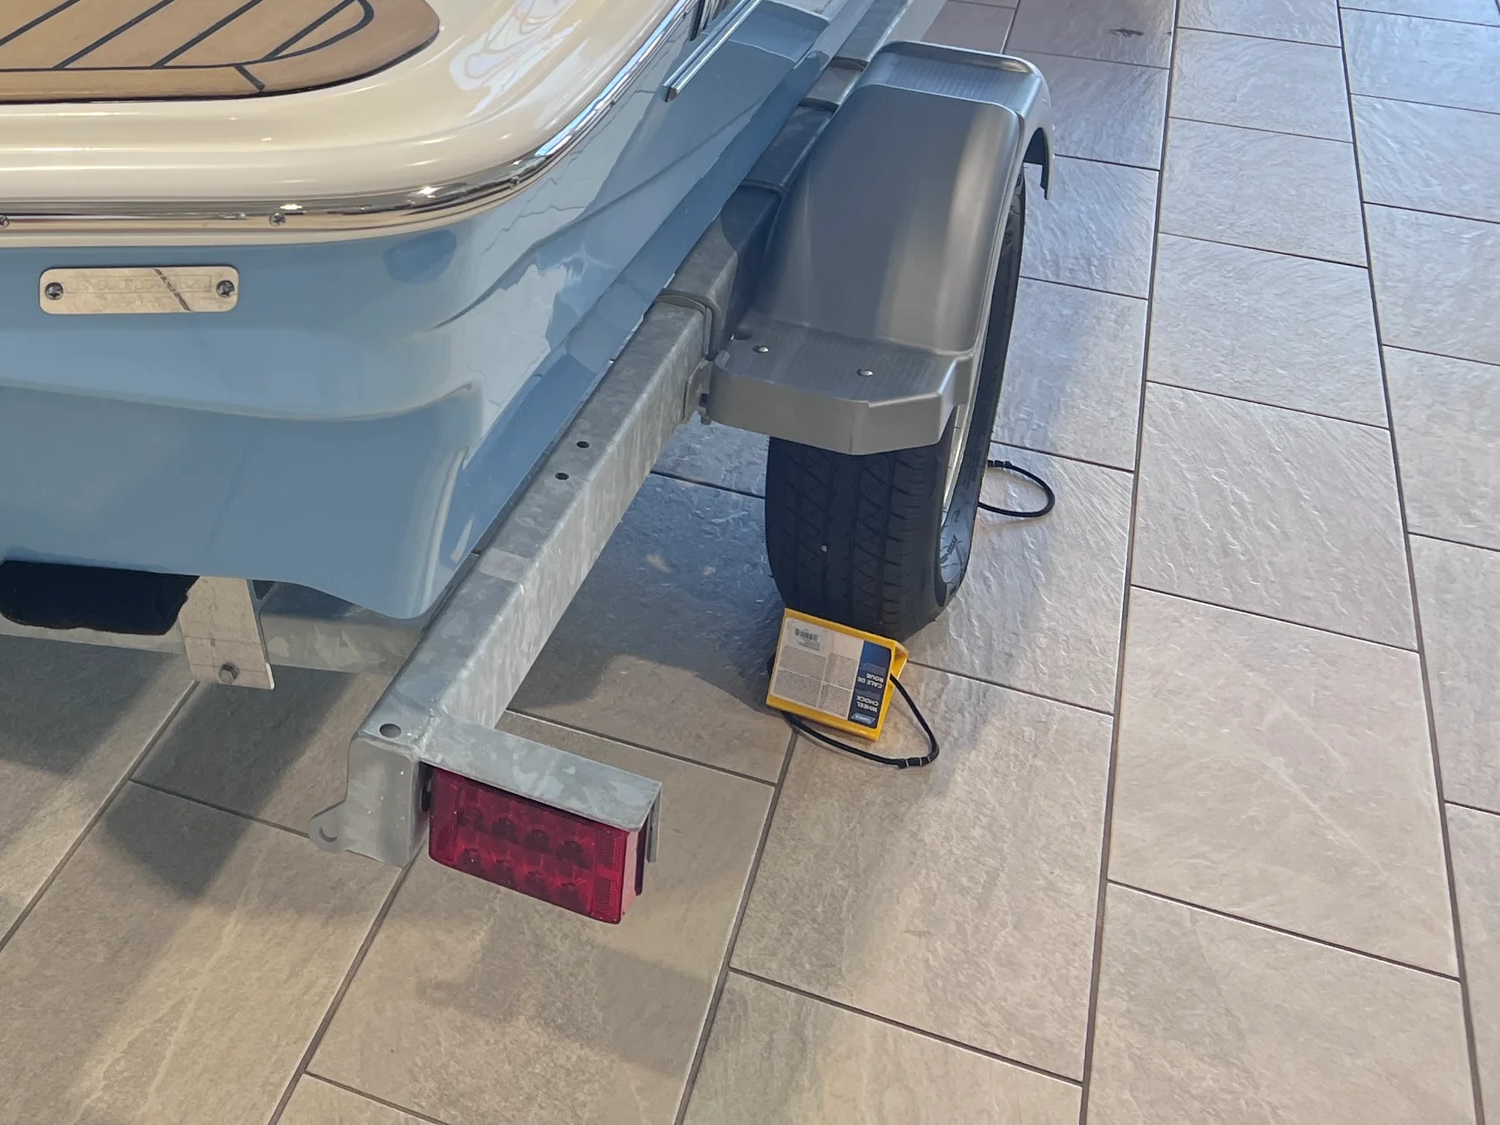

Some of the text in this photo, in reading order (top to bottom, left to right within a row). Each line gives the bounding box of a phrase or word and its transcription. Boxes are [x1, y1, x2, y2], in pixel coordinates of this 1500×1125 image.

[857, 676, 883, 689] CALE DE
[866, 672, 884, 683] ROUE
[856, 695, 879, 707] CHOCK
[856, 701, 878, 713] WHEEL
